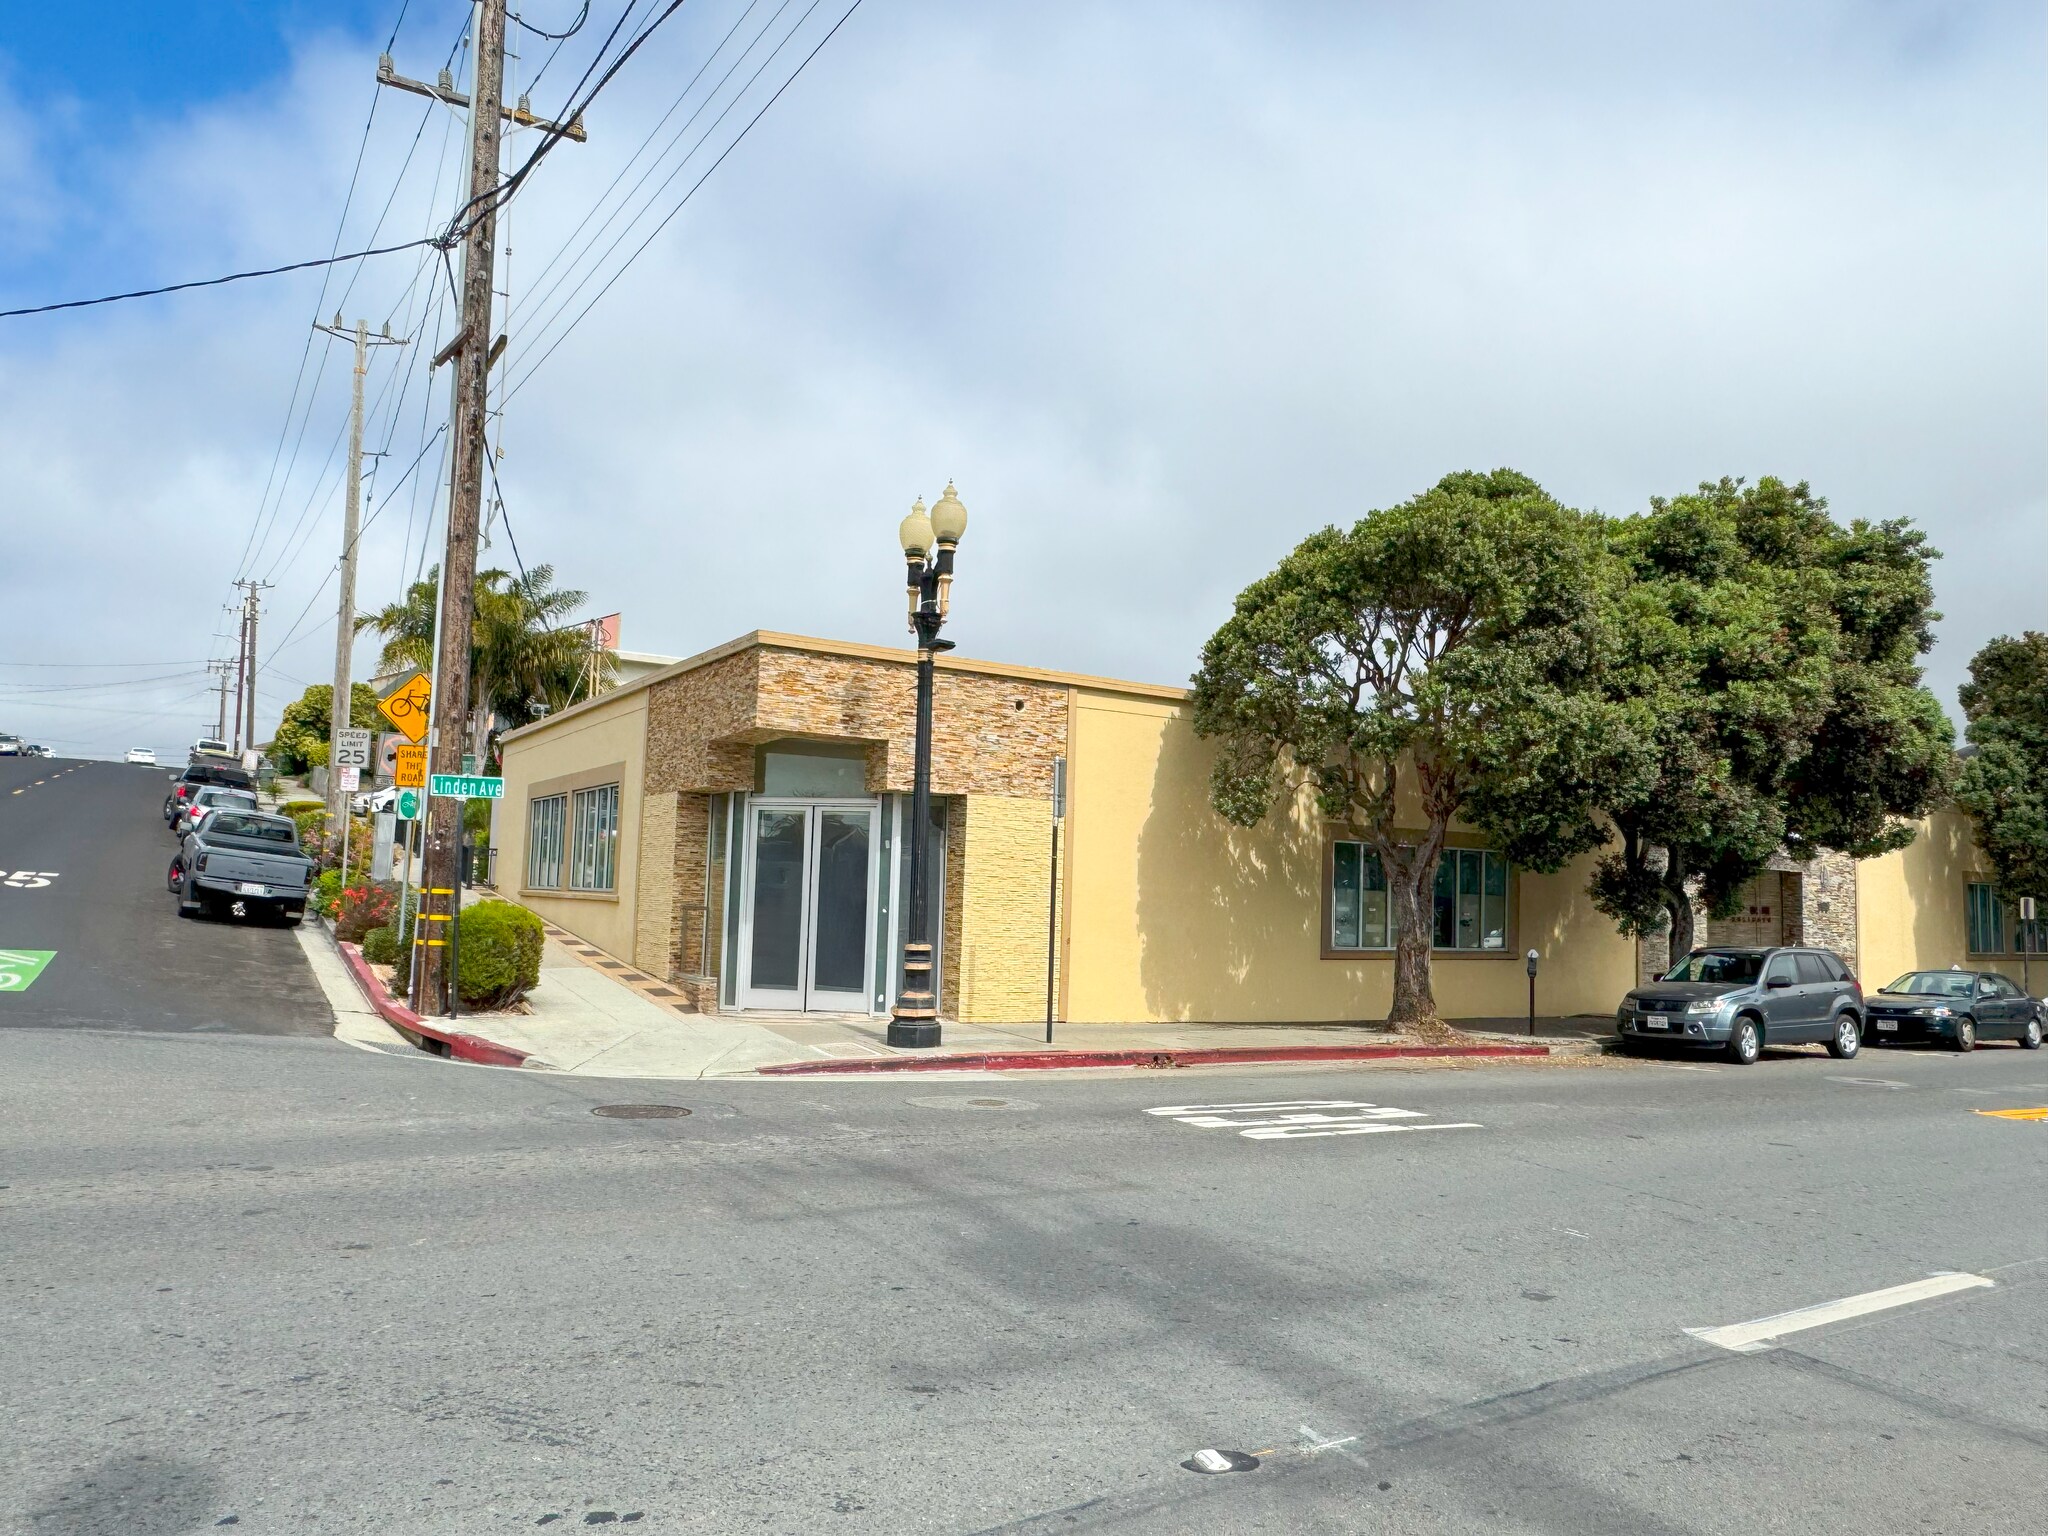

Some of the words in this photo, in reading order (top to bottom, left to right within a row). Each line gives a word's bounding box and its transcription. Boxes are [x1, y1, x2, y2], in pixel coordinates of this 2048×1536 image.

[338, 731, 368, 739] SPEED
[337, 749, 365, 764] 25
[400, 749, 428, 759] SHARE
[401, 773, 424, 782] ROAD
[432, 777, 477, 796] Linden
[479, 781, 502, 797] Ave
